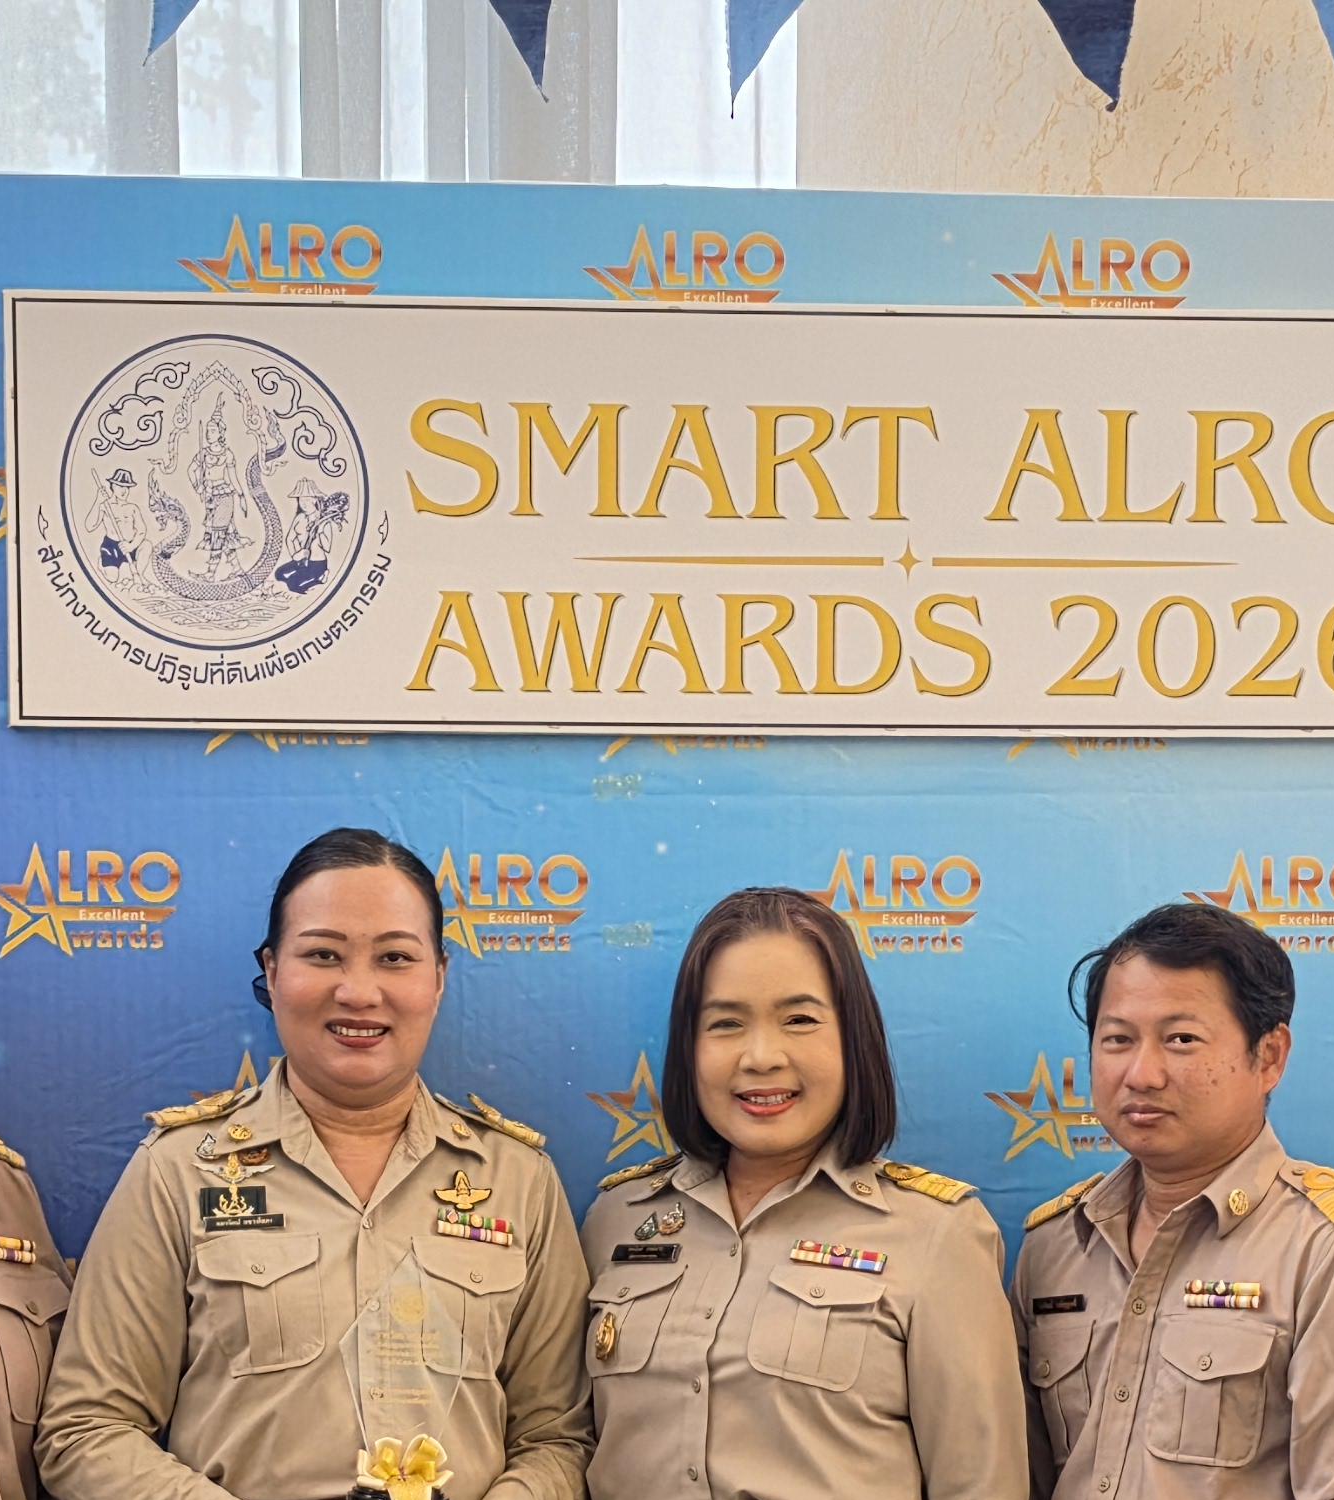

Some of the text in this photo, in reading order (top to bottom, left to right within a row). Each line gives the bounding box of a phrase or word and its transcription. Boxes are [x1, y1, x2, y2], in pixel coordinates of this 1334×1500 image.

[176, 214, 382, 288] ALRO
[582, 223, 785, 295] ALRO
[990, 230, 1190, 302] ALRO
[406, 399, 939, 522] SMART
[37, 544, 393, 691] สำนักงานการปฏิรูปที่ดินเพื่อเกษตรกรรม
[405, 590, 994, 698] AWARDS
[79, 909, 146, 921] Excellent
[435, 846, 588, 916] ALRO
[803, 849, 981, 917] ALRO
[489, 912, 555, 925] Excellent
[882, 913, 947, 926] Excellent
